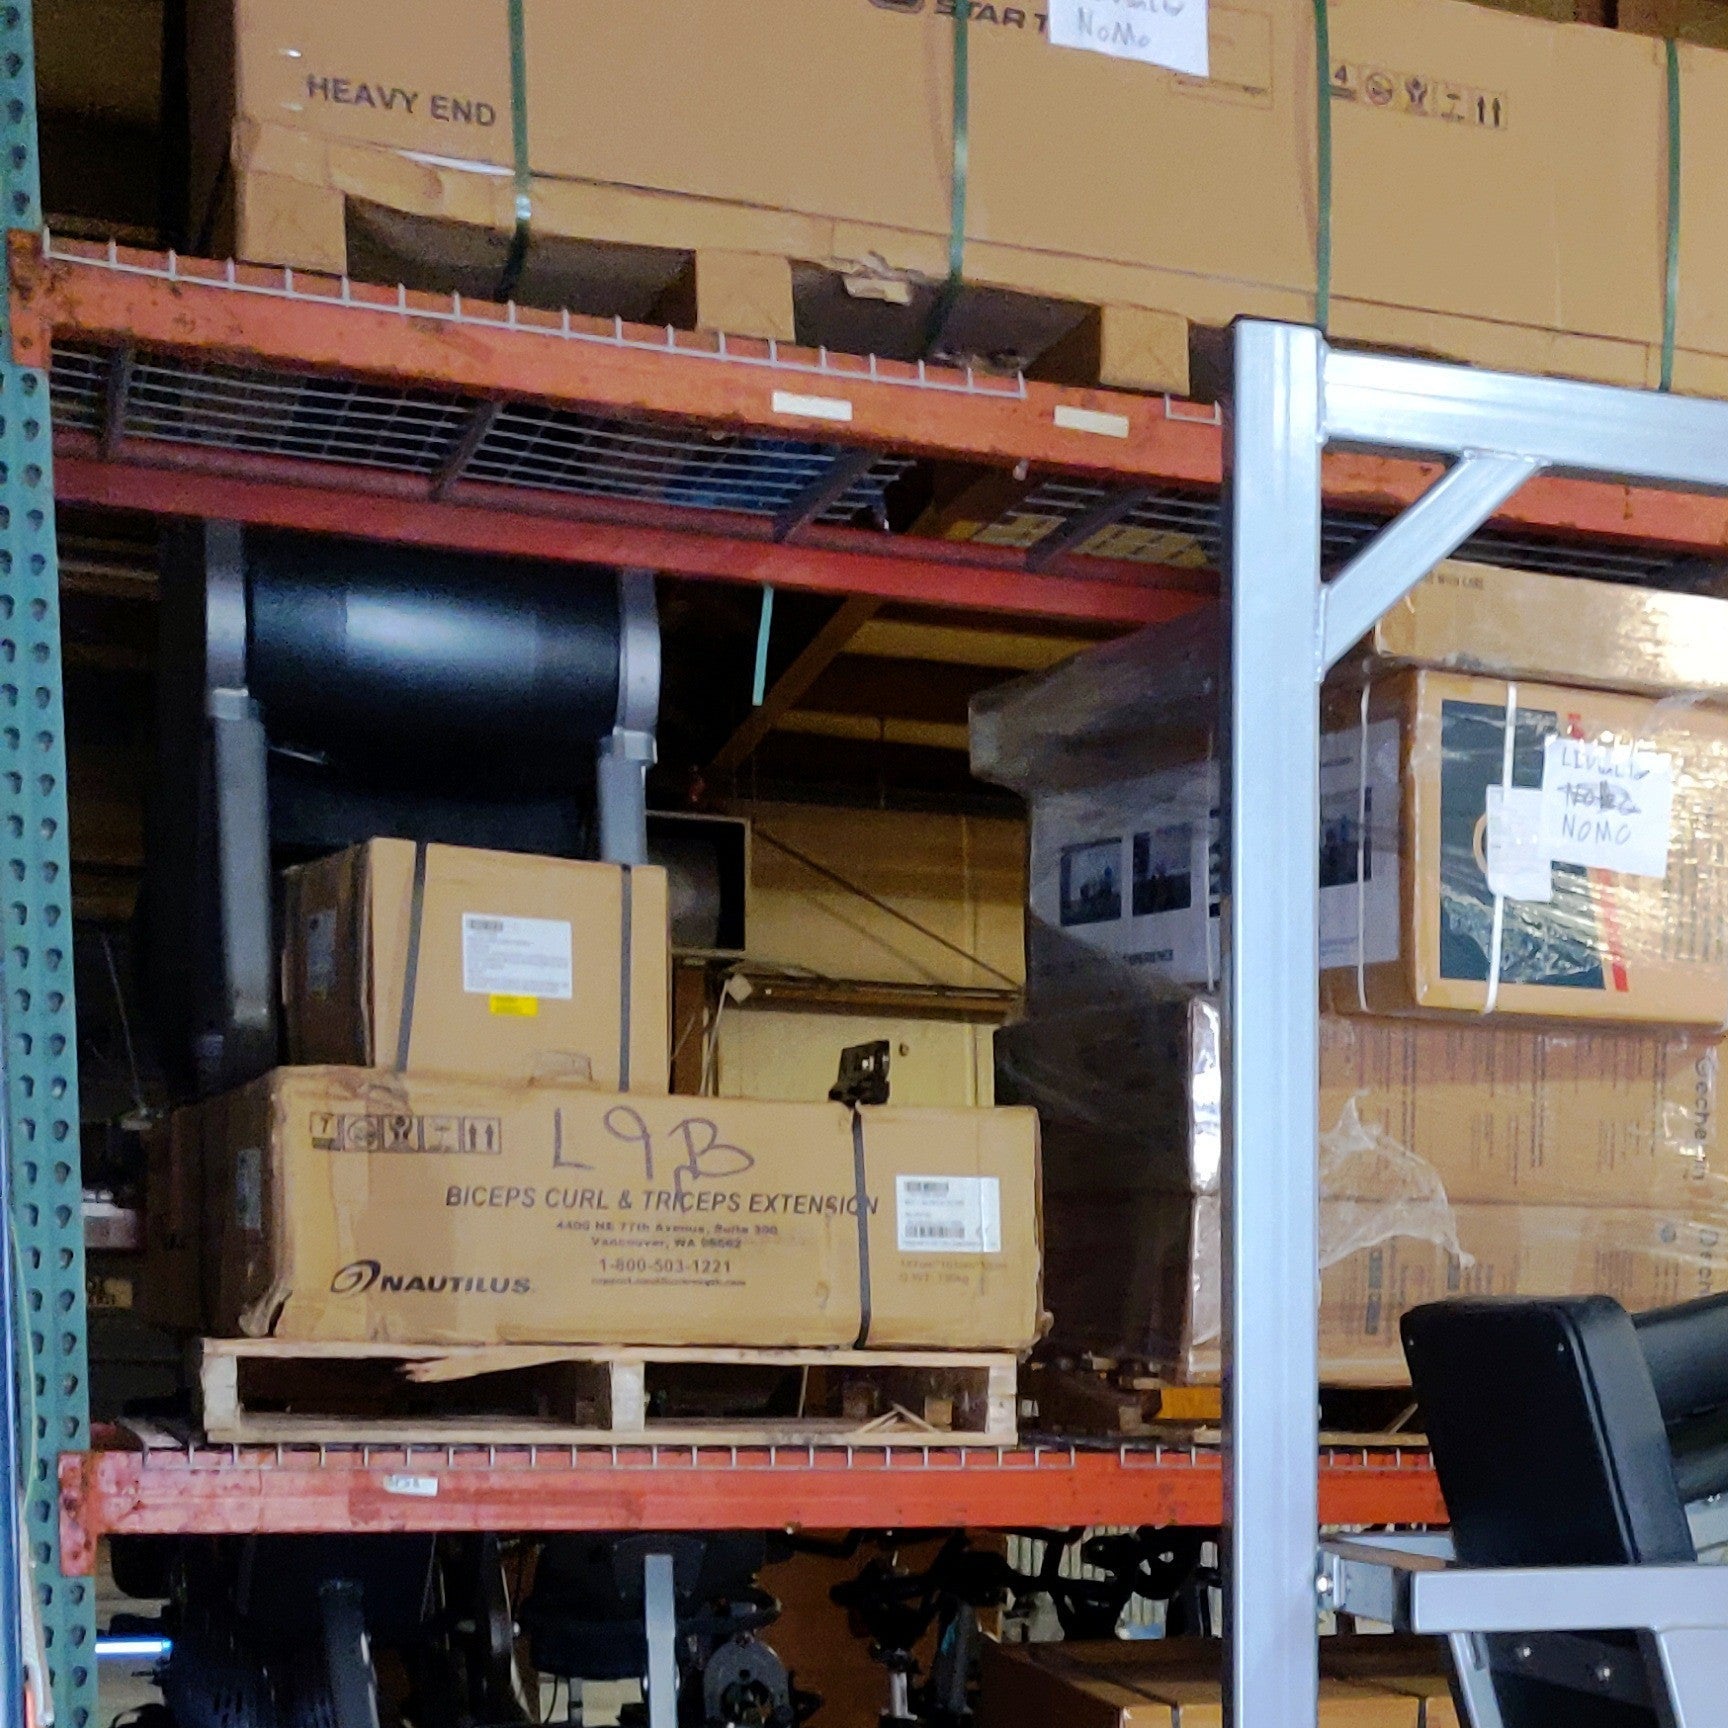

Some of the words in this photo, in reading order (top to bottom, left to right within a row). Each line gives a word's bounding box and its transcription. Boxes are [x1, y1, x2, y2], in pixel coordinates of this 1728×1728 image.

[306, 73, 418, 114] HEAVY
[431, 94, 497, 127] END
[1562, 813, 1632, 845] NOMO
[445, 1185, 536, 1209] BICEPS
[545, 1187, 609, 1210] CURL
[618, 1189, 632, 1210] &
[643, 1189, 742, 1212] TRICEPS
[748, 1192, 879, 1215] EXTENSION
[599, 1257, 732, 1273] 1-800-503-1221
[380, 1274, 531, 1294] NAUTILUS
